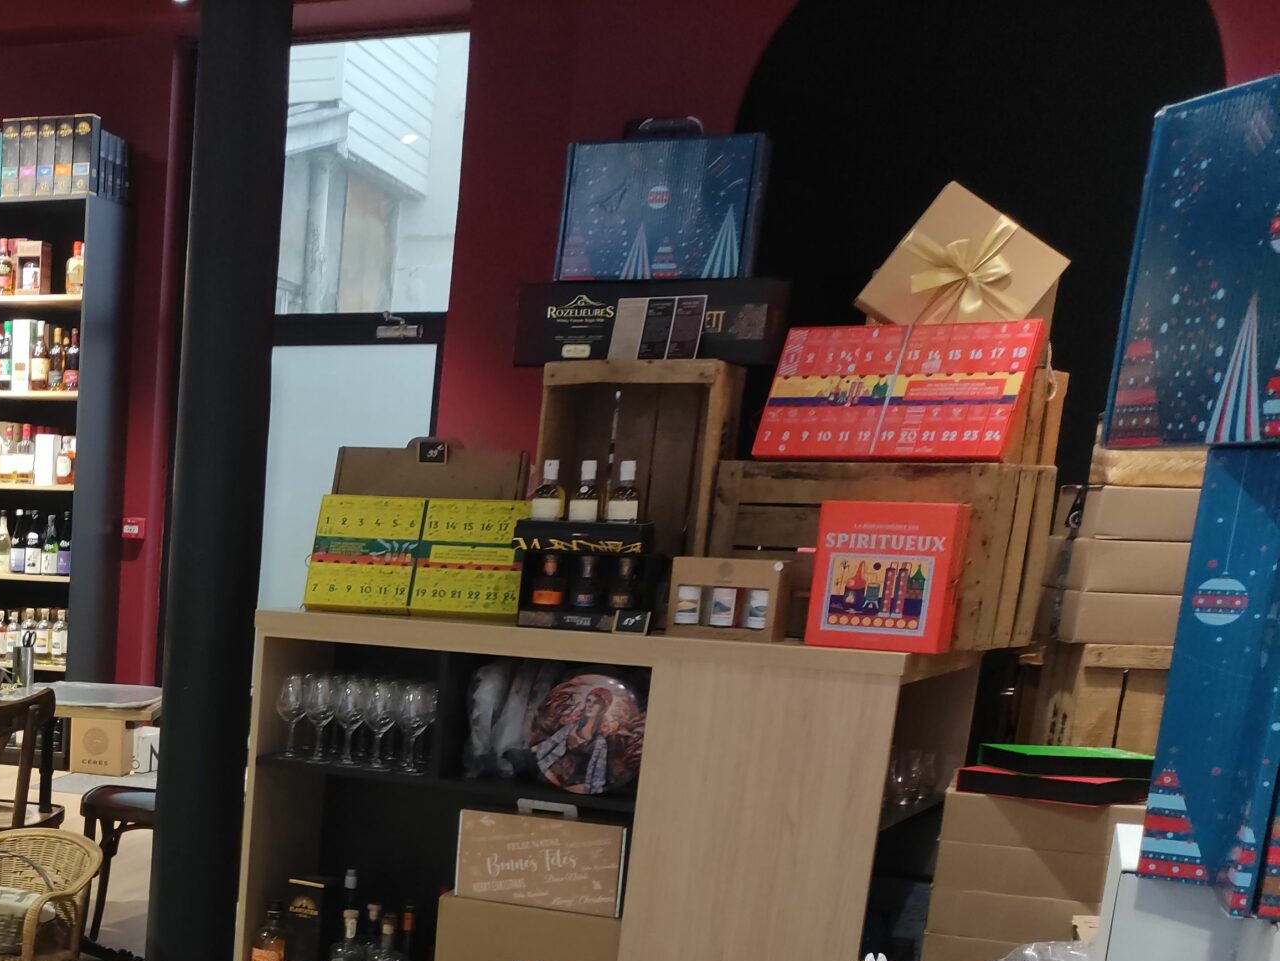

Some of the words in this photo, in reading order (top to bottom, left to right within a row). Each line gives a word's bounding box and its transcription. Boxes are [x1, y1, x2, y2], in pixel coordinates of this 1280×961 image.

[547, 306, 615, 319] ROZELIEURES
[948, 349, 962, 360] 15
[969, 348, 984, 360] 16
[990, 347, 1005, 359] 17
[1011, 346, 1027, 358] 18
[817, 431, 832, 441] 10
[838, 431, 850, 441] 11
[857, 431, 872, 441] 12
[881, 430, 895, 441] 19
[921, 430, 936, 441] 21
[941, 430, 958, 441] 22
[962, 430, 980, 441] 23
[983, 430, 1001, 441] 24
[326, 516, 330, 524] 1
[341, 517, 347, 525] 2
[358, 518, 365, 526] 3
[374, 518, 381, 527] 4
[392, 519, 399, 527] 5
[409, 520, 416, 528] 6
[429, 520, 439, 529] 13
[446, 521, 456, 530] 14
[463, 522, 474, 531] 15
[480, 522, 492, 531] 16
[498, 522, 510, 531] 17
[825, 532, 946, 552] SPIRITUEUX
[312, 584, 318, 592] 7
[328, 584, 336, 592] 8
[346, 584, 352, 593] 9
[360, 585, 372, 594] 10
[378, 586, 388, 595] 11
[395, 587, 406, 596] 12
[416, 588, 427, 597] 19
[431, 589, 446, 598] 20
[450, 590, 462, 598] 21
[466, 591, 481, 600] 22
[485, 592, 498, 600] 23
[503, 591, 517, 601] 24
